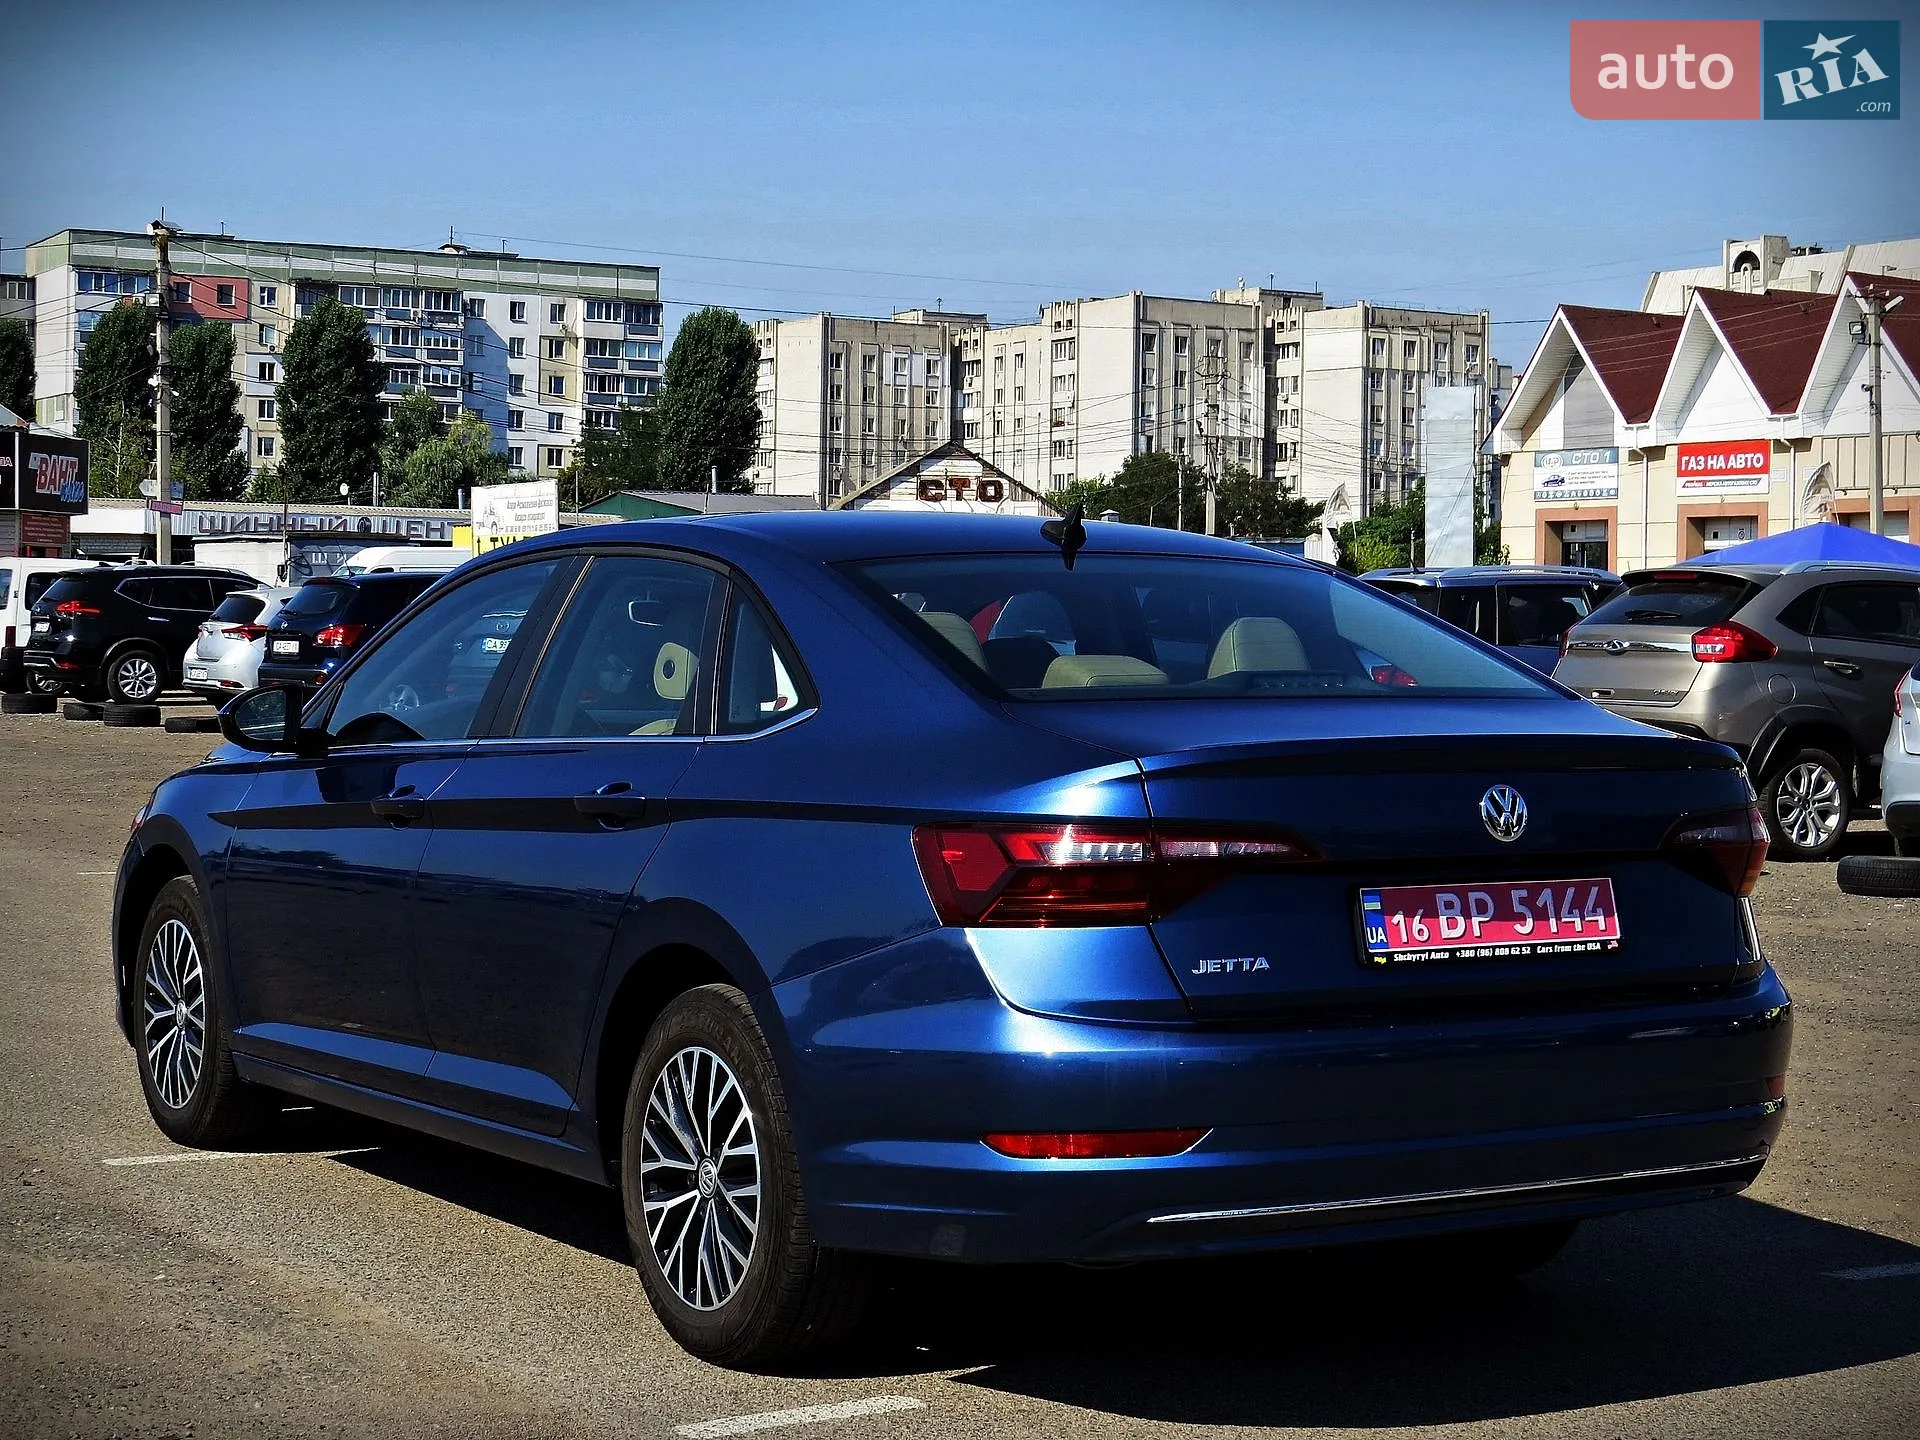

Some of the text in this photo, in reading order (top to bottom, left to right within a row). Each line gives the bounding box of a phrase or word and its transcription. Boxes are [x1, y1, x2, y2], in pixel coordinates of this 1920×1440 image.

[1681, 452, 1764, 471] ГАЗ НА АВТО
[918, 477, 1004, 503] СТО
[199, 515, 348, 534] ШИННЫЙ
[1391, 886, 1607, 944] 16 BP 5144
[1367, 926, 1388, 944] UA
[1430, 951, 1449, 960] Auto
[1456, 949, 1475, 958] +380
[1521, 946, 1531, 955] 52
[1536, 945, 1553, 954] Cars
[1554, 944, 1572, 953] from
[1573, 944, 1586, 952] the
[1587, 943, 1601, 951] USA
[1191, 957, 1271, 975] JETTA
